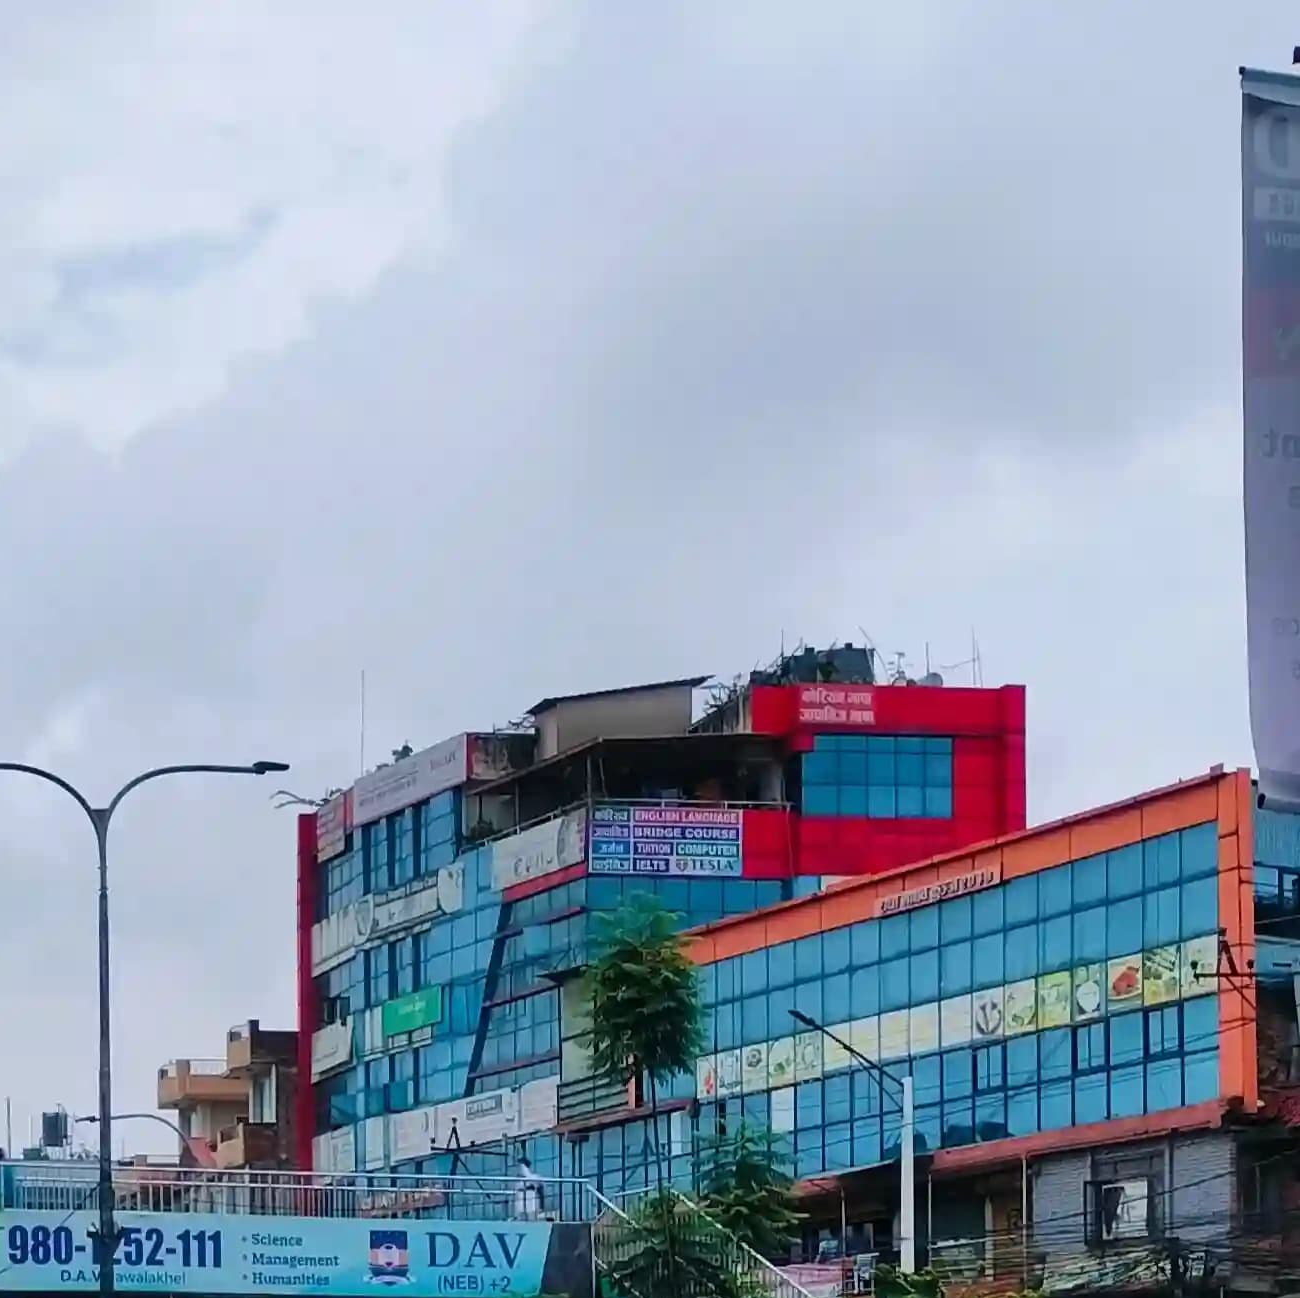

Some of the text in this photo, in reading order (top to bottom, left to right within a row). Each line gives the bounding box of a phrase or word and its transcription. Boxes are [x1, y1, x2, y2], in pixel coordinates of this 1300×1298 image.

[634, 827, 737, 839] BRIDGE COURSE
[678, 844, 737, 855] COMPUTER
[251, 1233, 303, 1246] Science
[9, 1225, 222, 1268] 980-152-111
[251, 1252, 340, 1268] Management
[114, 1271, 186, 1285] awalakhel
[251, 1273, 330, 1286] Humanities
[438, 1274, 510, 1294] (NEB) +2
